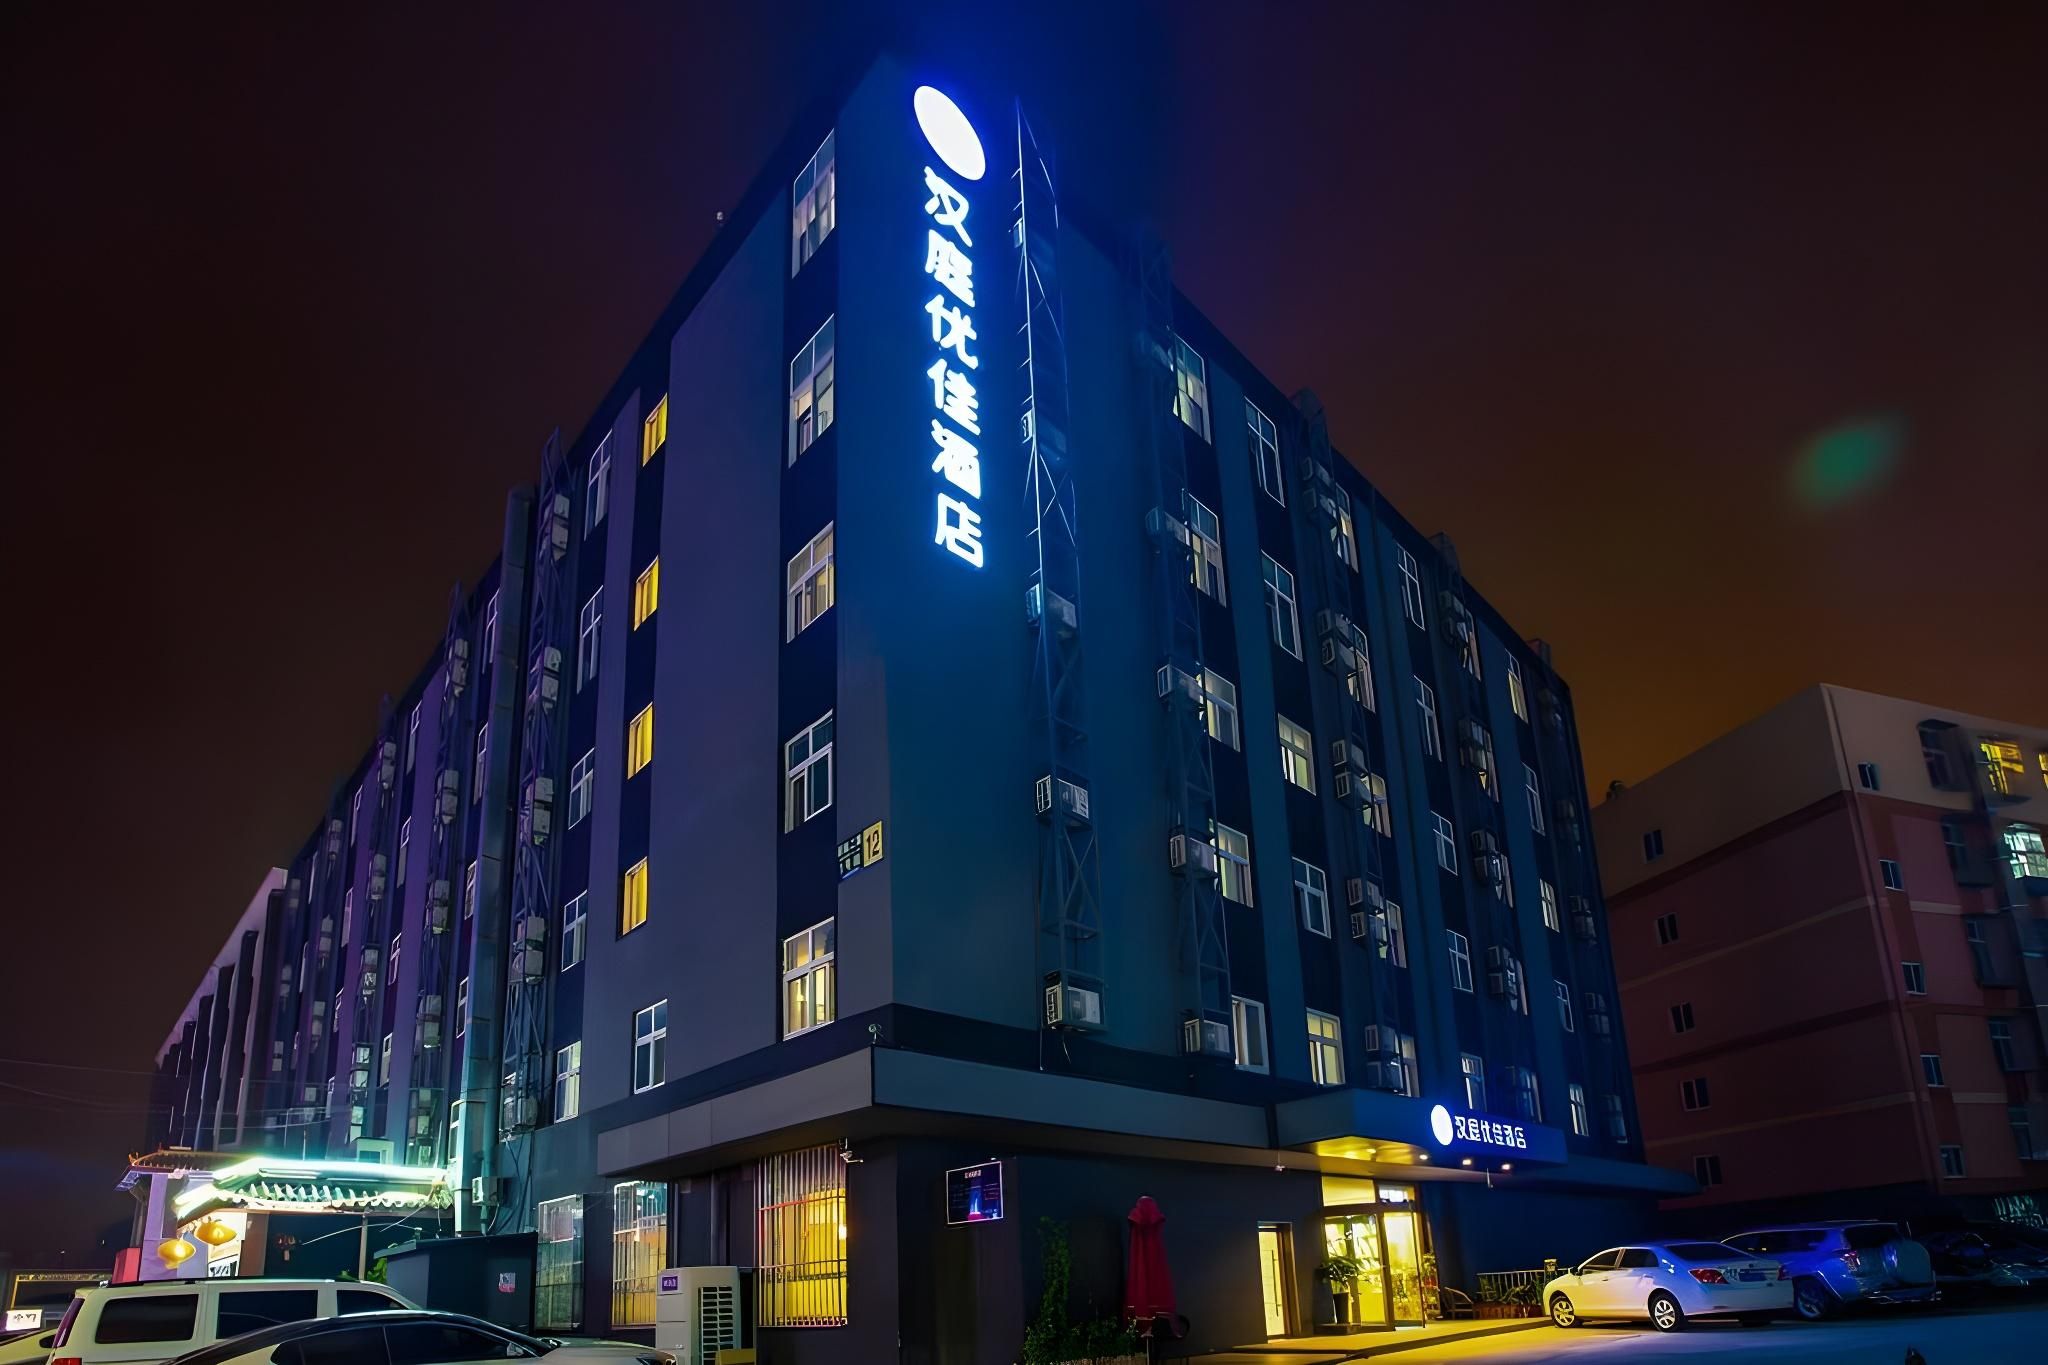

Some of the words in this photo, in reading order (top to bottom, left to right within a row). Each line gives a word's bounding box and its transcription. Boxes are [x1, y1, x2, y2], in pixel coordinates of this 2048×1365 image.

[924, 165, 984, 569] 汉庭优佳酒店
[866, 828, 881, 860] 12
